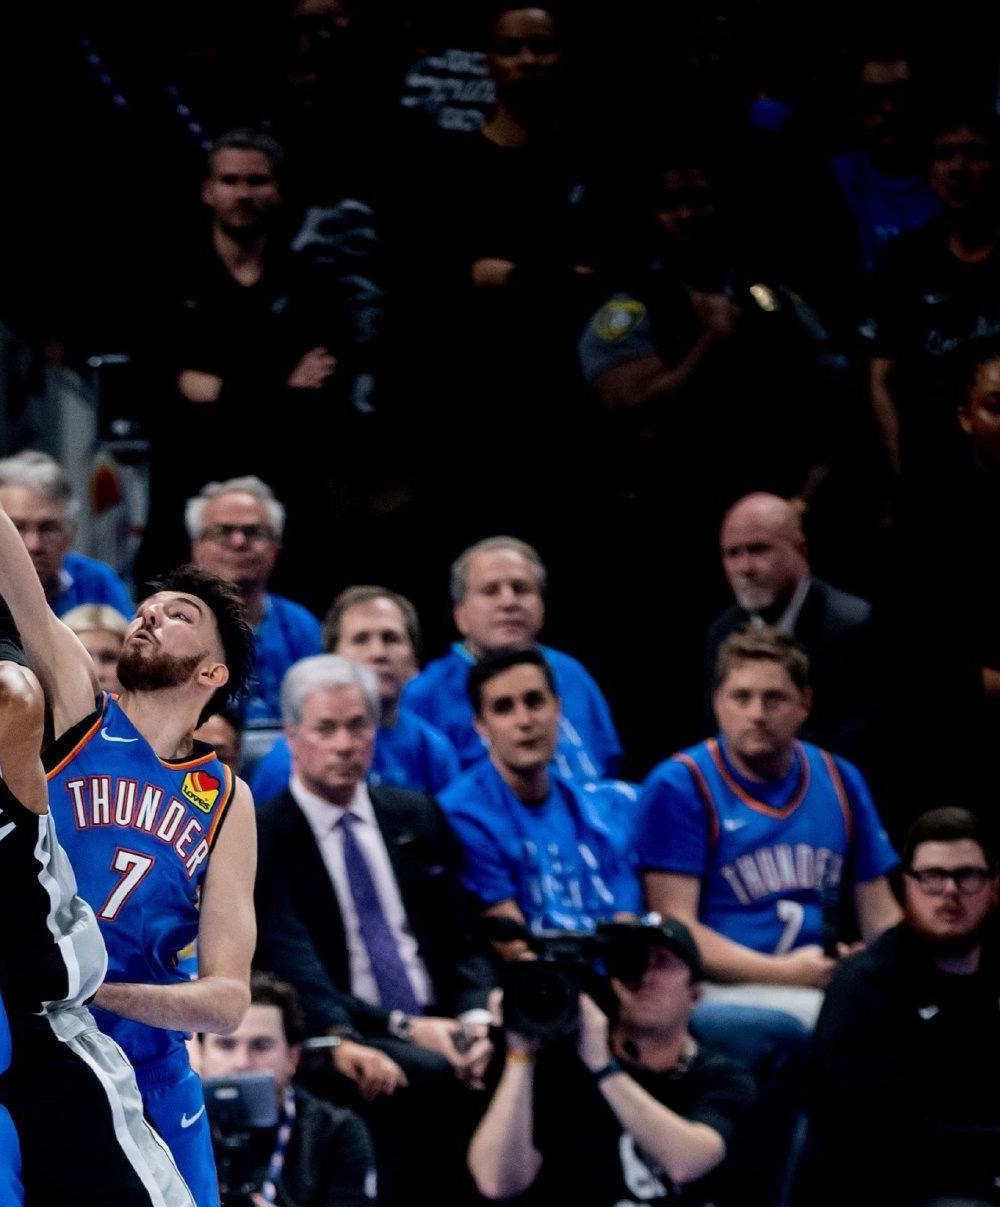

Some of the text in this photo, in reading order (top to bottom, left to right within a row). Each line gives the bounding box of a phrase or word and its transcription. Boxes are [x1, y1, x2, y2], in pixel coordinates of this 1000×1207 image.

[66, 775, 210, 879] THUNDER
[97, 846, 156, 923] 7
[775, 898, 805, 958] 7
